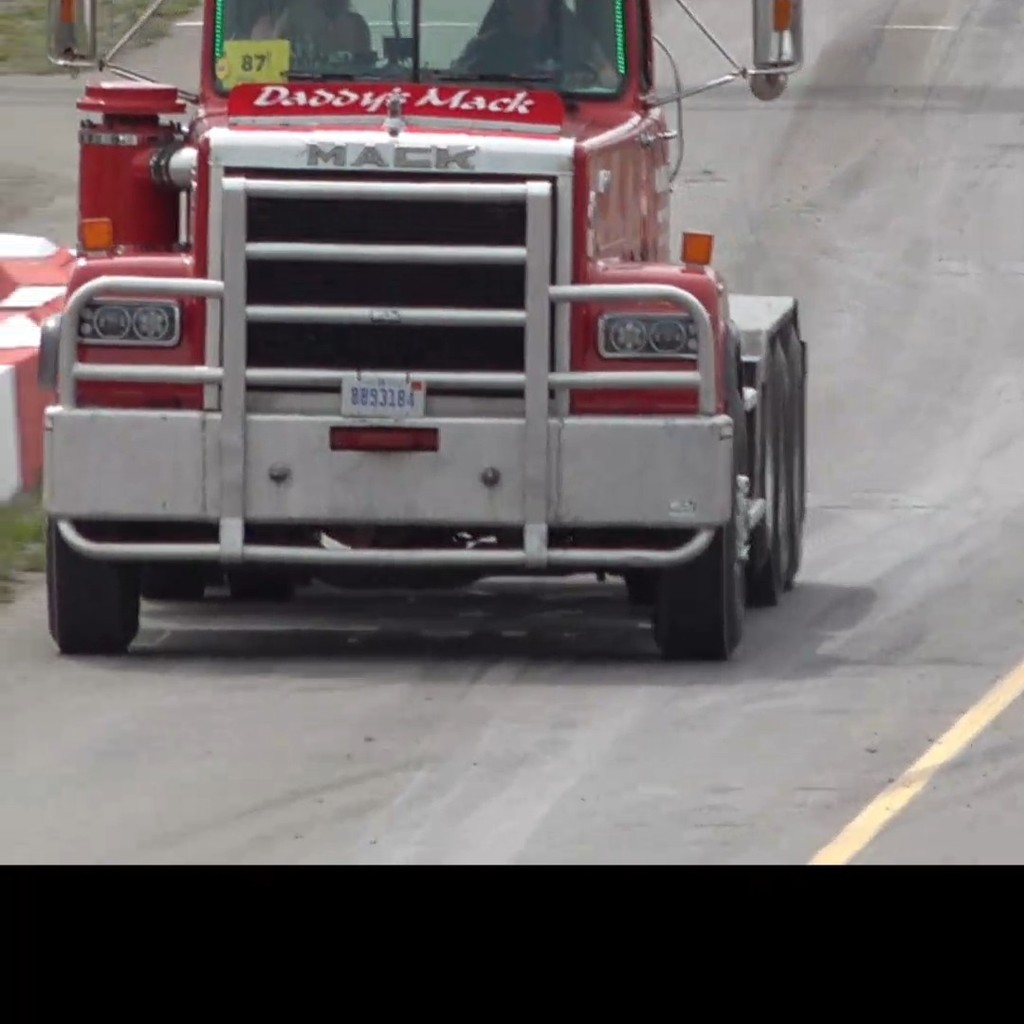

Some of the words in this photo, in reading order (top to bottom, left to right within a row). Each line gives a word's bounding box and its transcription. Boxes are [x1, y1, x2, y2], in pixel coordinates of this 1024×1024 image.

[241, 54, 266, 72] 87
[414, 87, 535, 114] Mack
[306, 143, 479, 170] MACK
